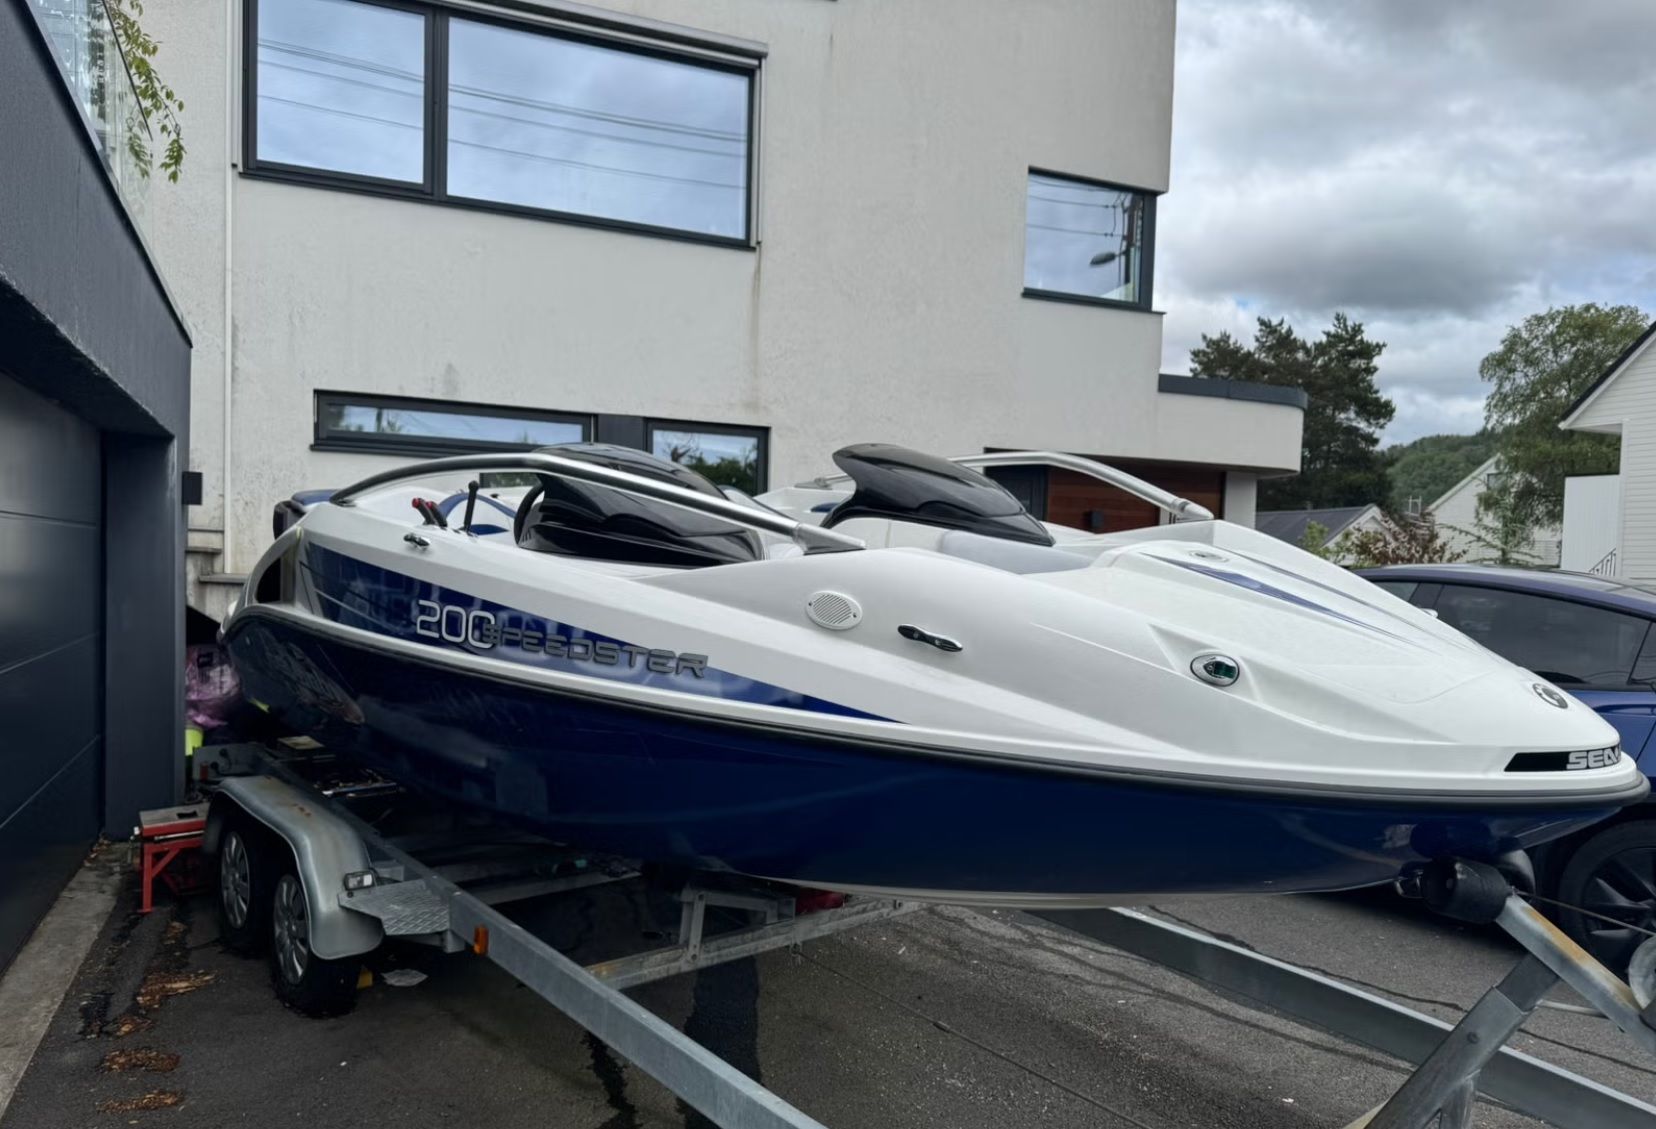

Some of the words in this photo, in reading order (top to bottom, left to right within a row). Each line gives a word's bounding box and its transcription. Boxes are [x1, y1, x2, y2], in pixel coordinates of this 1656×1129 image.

[416, 599, 496, 650] 200
[482, 622, 709, 679] SPEEDSTER
[1566, 745, 1620, 770] SEA
